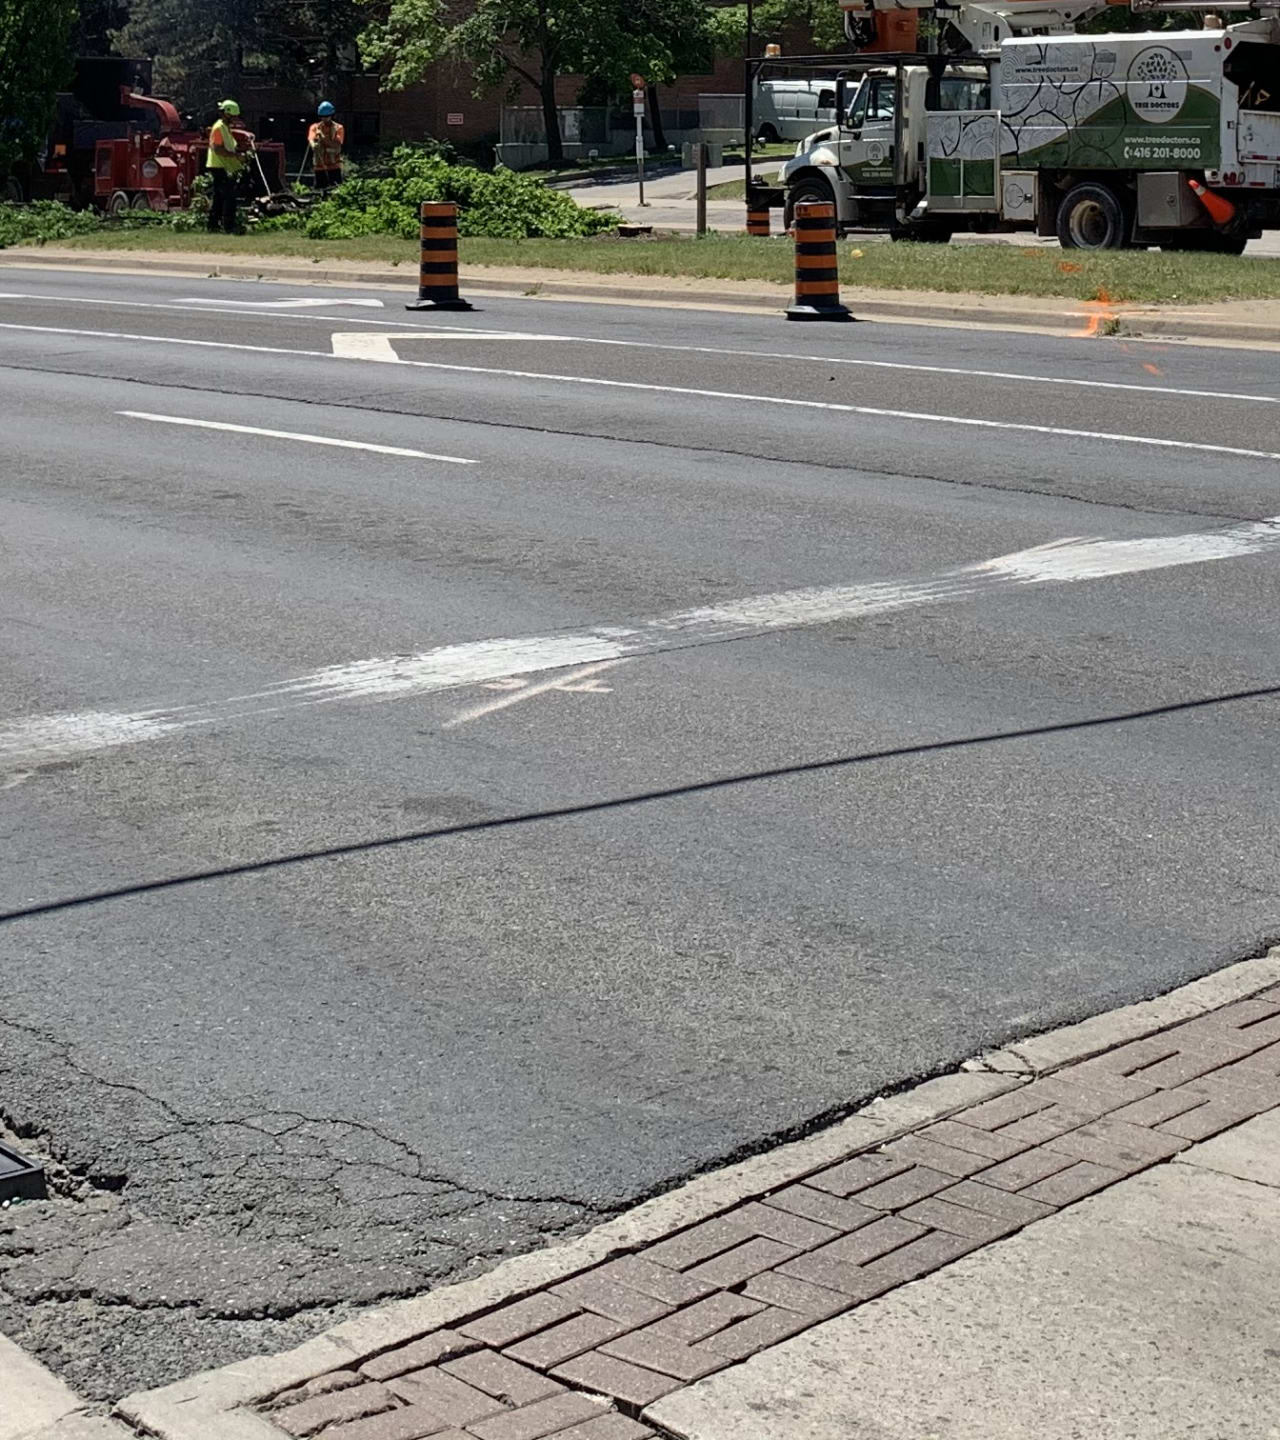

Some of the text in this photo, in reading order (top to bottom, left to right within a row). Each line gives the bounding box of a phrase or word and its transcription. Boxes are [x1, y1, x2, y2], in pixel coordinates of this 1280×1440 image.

[1124, 136, 1201, 144] www.treedoctors.ca
[1134, 147, 1201, 159] 416 201-8000
